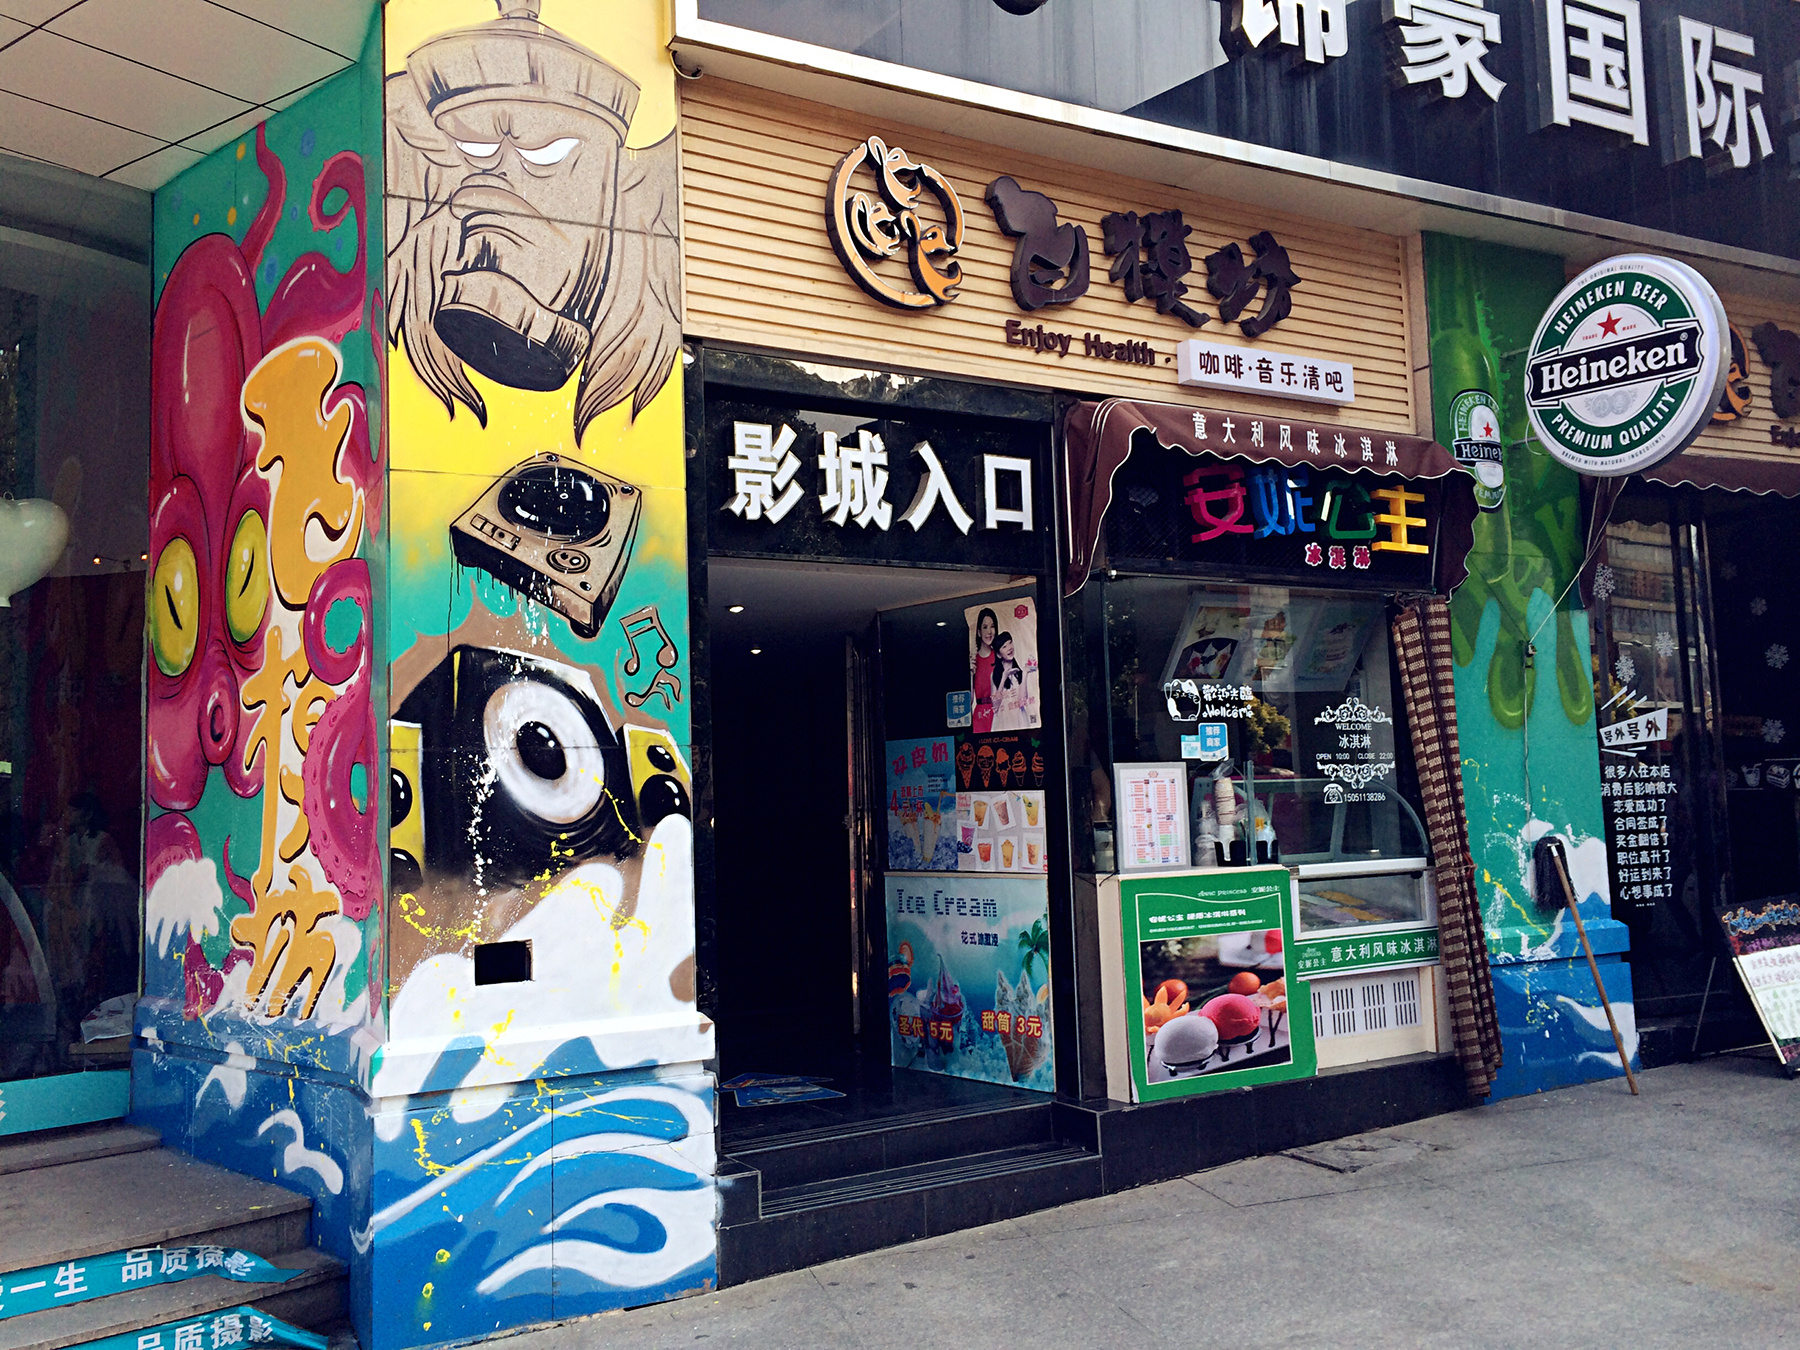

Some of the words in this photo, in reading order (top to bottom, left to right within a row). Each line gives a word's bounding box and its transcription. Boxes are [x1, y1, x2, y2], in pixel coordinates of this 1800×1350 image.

[1554, 280, 1625, 335] HEINEKEN
[1631, 280, 1669, 311] BEER
[1005, 319, 1072, 357] Enjoy
[1084, 331, 1155, 365] Health
[1199, 350, 1344, 393] 咖啡·音乐清吧
[1540, 342, 1688, 394] Heineken
[1551, 412, 1613, 450] PREMIUM
[1619, 391, 1676, 445] QUALITY
[1192, 411, 1399, 467] 意大利风味冰淇淋
[724, 420, 1034, 536] 影城入口
[1183, 464, 1430, 555] 安妮公主
[1304, 542, 1371, 569] 冰淇淋
[1335, 723, 1372, 731] WELCOME
[1339, 733, 1371, 749] 冰淇淋
[892, 741, 949, 775] 双皮奶
[1379, 752, 1394, 760] 22:00
[1604, 764, 1671, 779] 很多人在本店
[1601, 781, 1678, 797] 消费后影响很大
[1613, 799, 1667, 813] 恋爱成功了
[1614, 816, 1668, 831] 合同签成了
[1616, 832, 1669, 848] 奖金翻倍了
[1617, 850, 1671, 865] 职位高升了
[1618, 866, 1672, 884] 好运到来了
[897, 888, 926, 914] Ice
[933, 890, 998, 917] Cream
[1620, 884, 1673, 900] 心想事成了
[1330, 935, 1439, 963] 意大利风味冰淇淋
[898, 1015, 925, 1039] 圣代
[929, 1021, 954, 1043] 5元
[981, 1010, 1012, 1035] 甜筒
[1016, 1015, 1043, 1039] 3元
[0, 1262, 87, 1312] 一生
[121, 1246, 256, 1283] 品质摄影
